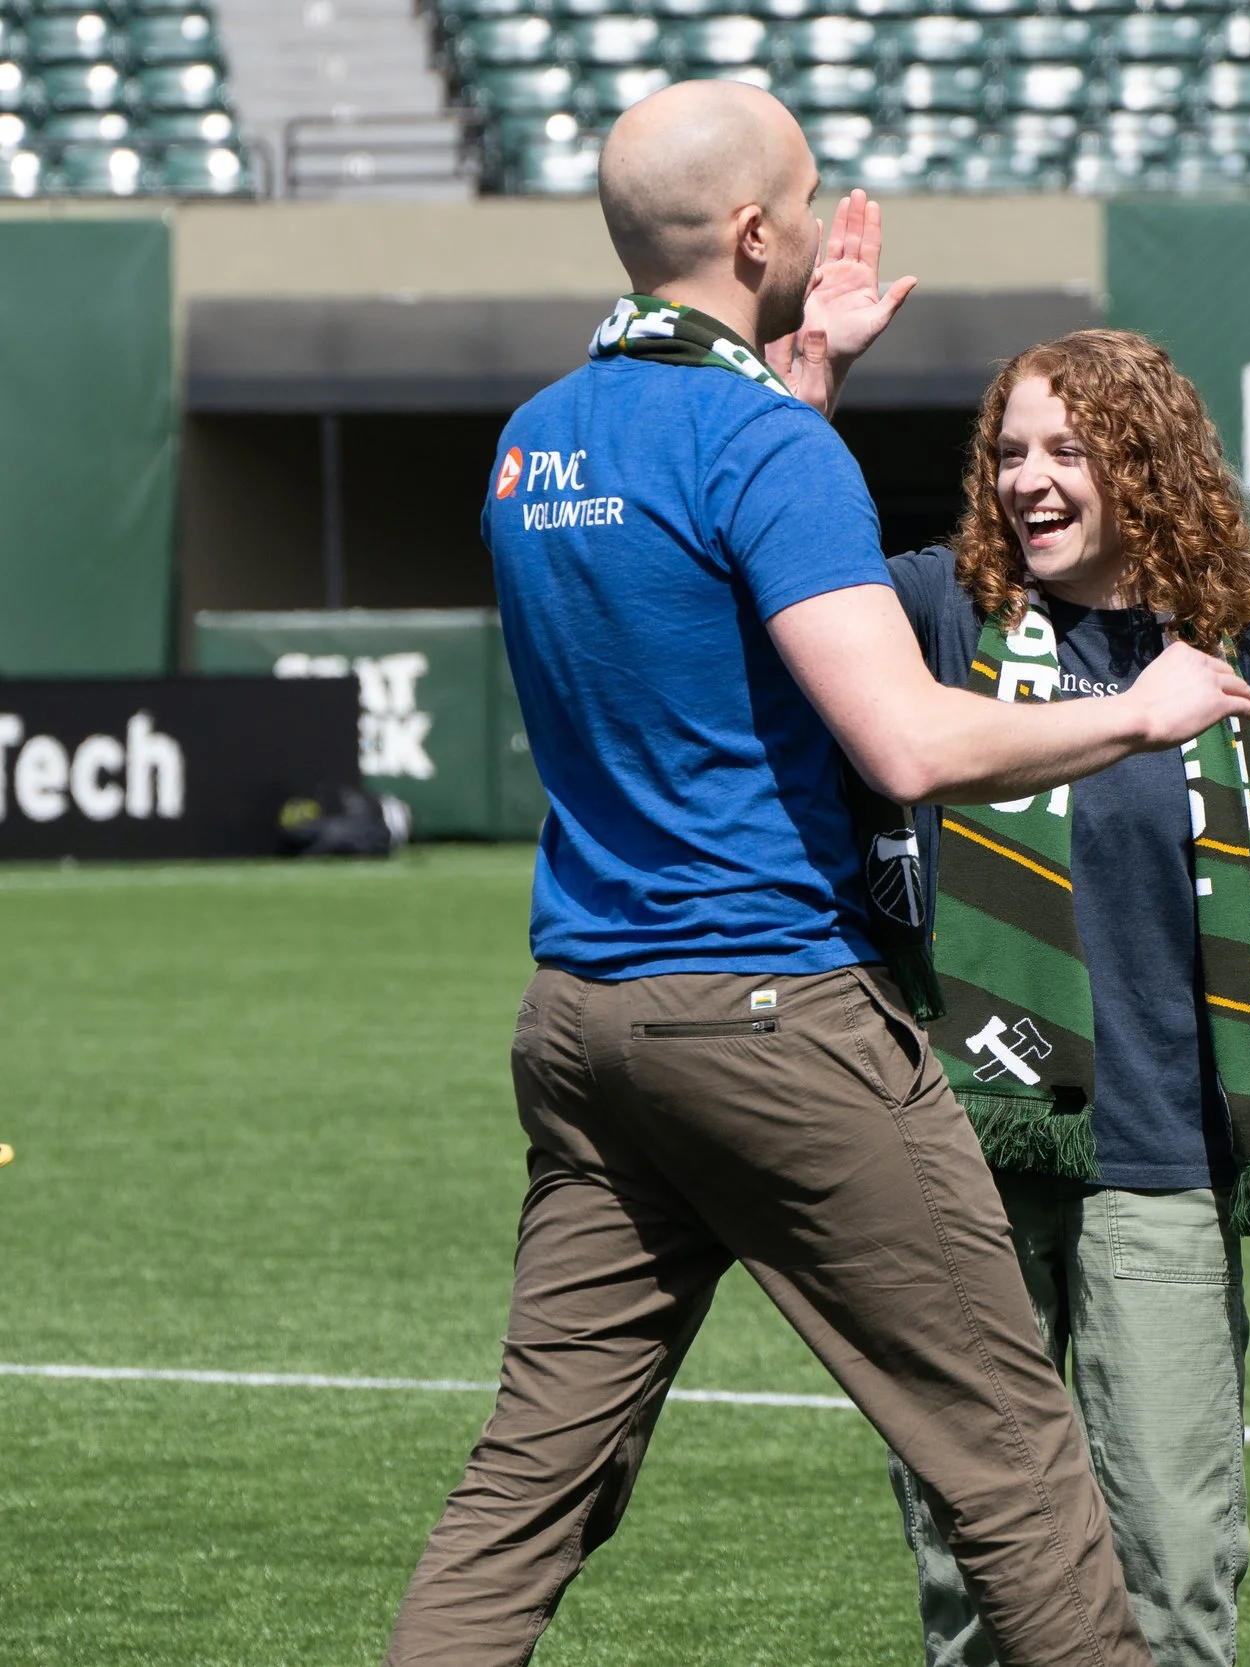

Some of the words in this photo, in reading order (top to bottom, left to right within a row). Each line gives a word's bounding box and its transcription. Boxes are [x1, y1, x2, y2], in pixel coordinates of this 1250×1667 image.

[526, 449, 587, 492] PNC
[522, 497, 624, 531] VOLUNTEER
[1057, 666, 1120, 699] ness
